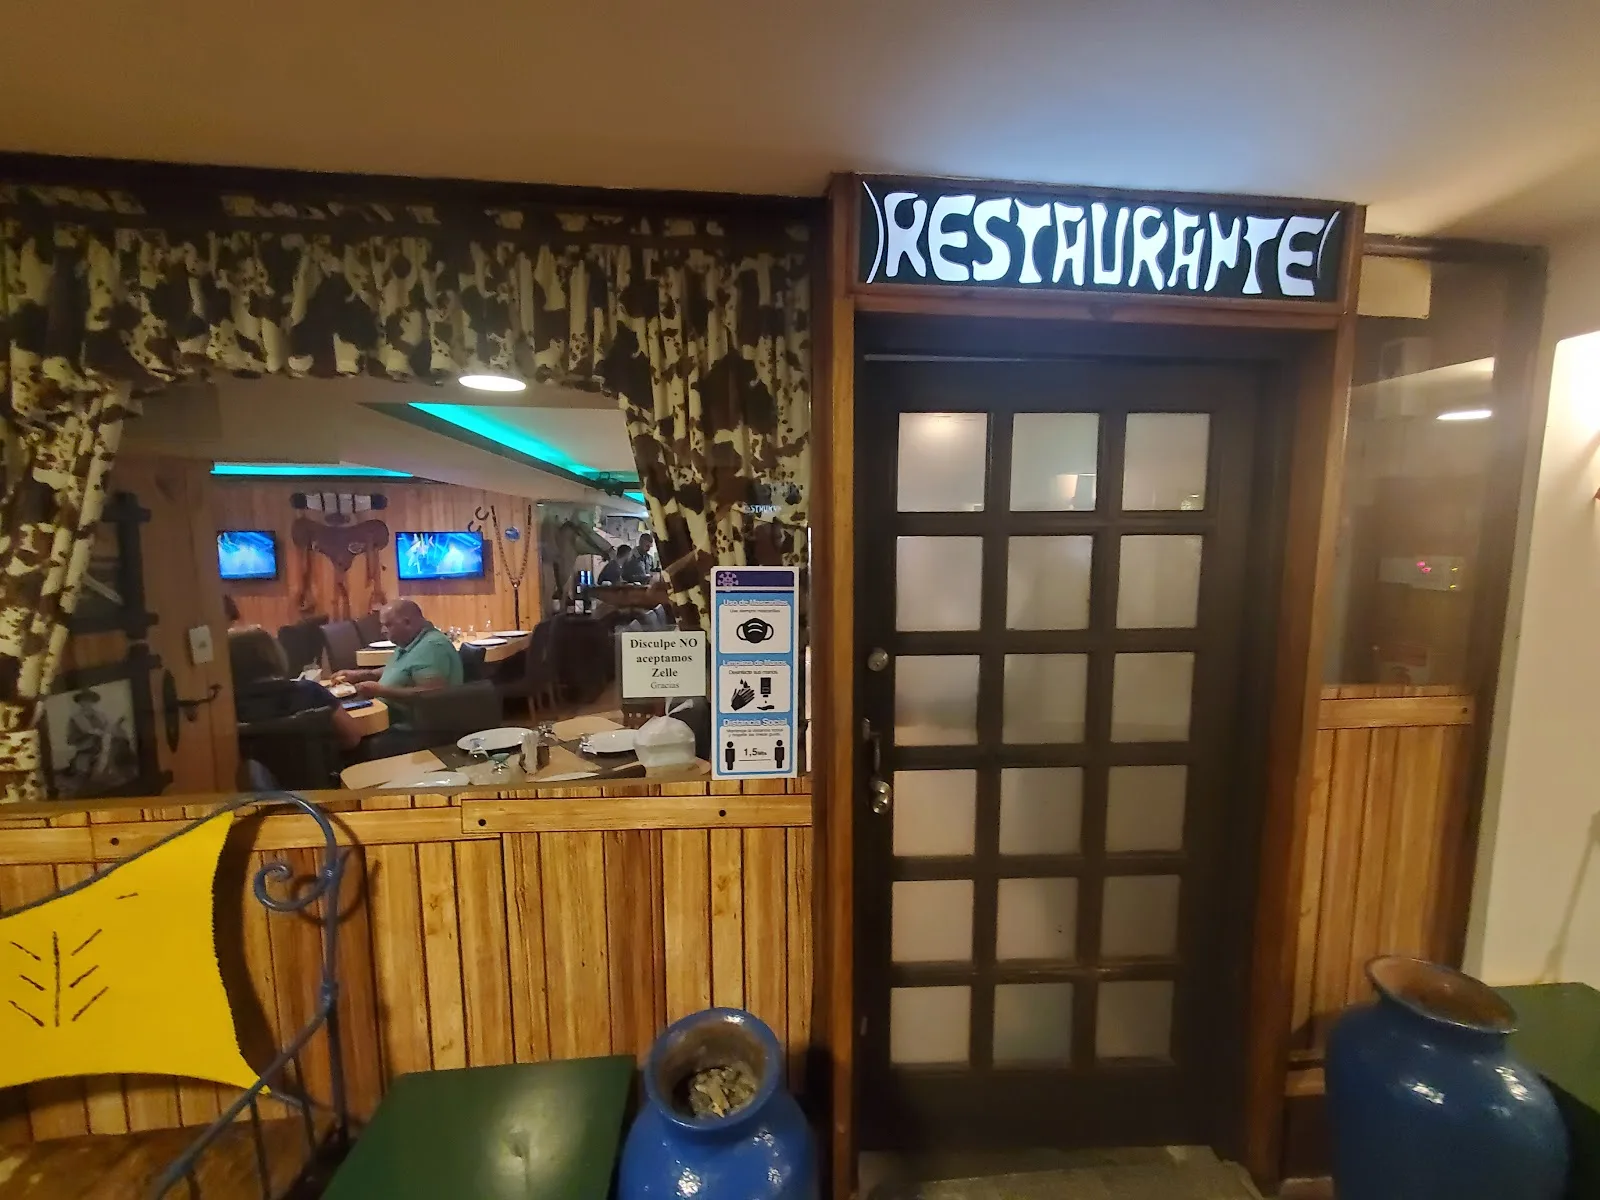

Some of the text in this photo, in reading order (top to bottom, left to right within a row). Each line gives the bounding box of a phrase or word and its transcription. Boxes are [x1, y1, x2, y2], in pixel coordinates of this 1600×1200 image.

[883, 191, 1327, 297] RESTAURANTE
[630, 637, 698, 651] Disculpe NO
[636, 655, 693, 666] aceptamos
[651, 667, 679, 678] Zelle
[650, 681, 680, 690] Gracias
[723, 717, 788, 727] Distancia Social
